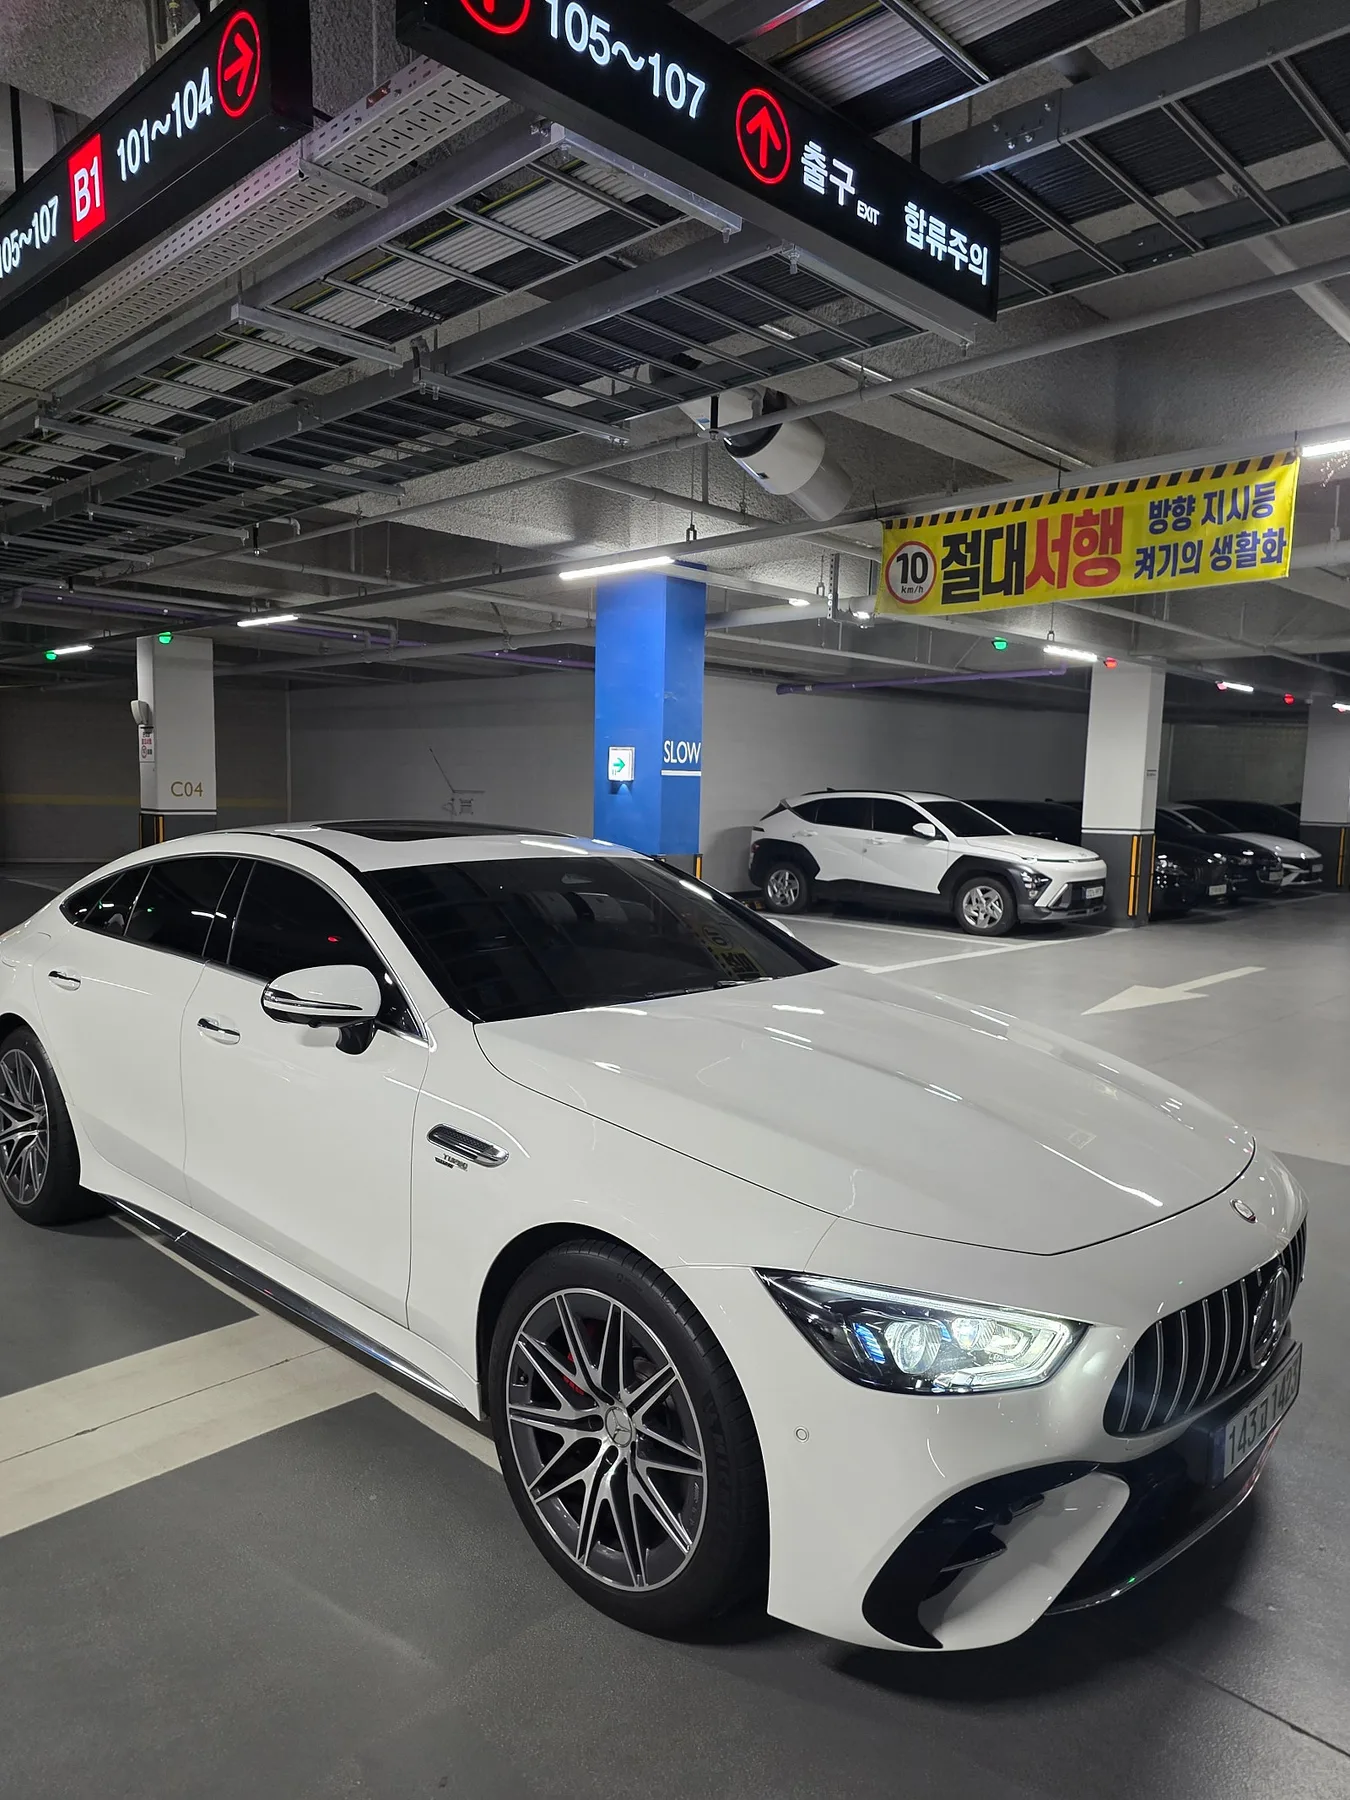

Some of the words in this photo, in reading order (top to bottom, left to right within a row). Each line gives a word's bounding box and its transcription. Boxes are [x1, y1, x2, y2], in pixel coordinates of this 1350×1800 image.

[73, 156, 101, 223] B1
[117, 67, 213, 182] 101~104
[801, 141, 856, 206] 출구
[857, 200, 880, 226] EXIT
[904, 201, 988, 286] 합류주의
[1149, 494, 1196, 535] 방향
[1201, 481, 1276, 525] 지시등
[896, 552, 928, 584] 10
[1134, 540, 1203, 580] 켜기의
[1210, 527, 1287, 571] 생활화
[901, 585, 924, 594] km/h
[663, 740, 701, 763] SLOW
[170, 781, 203, 797] C04
